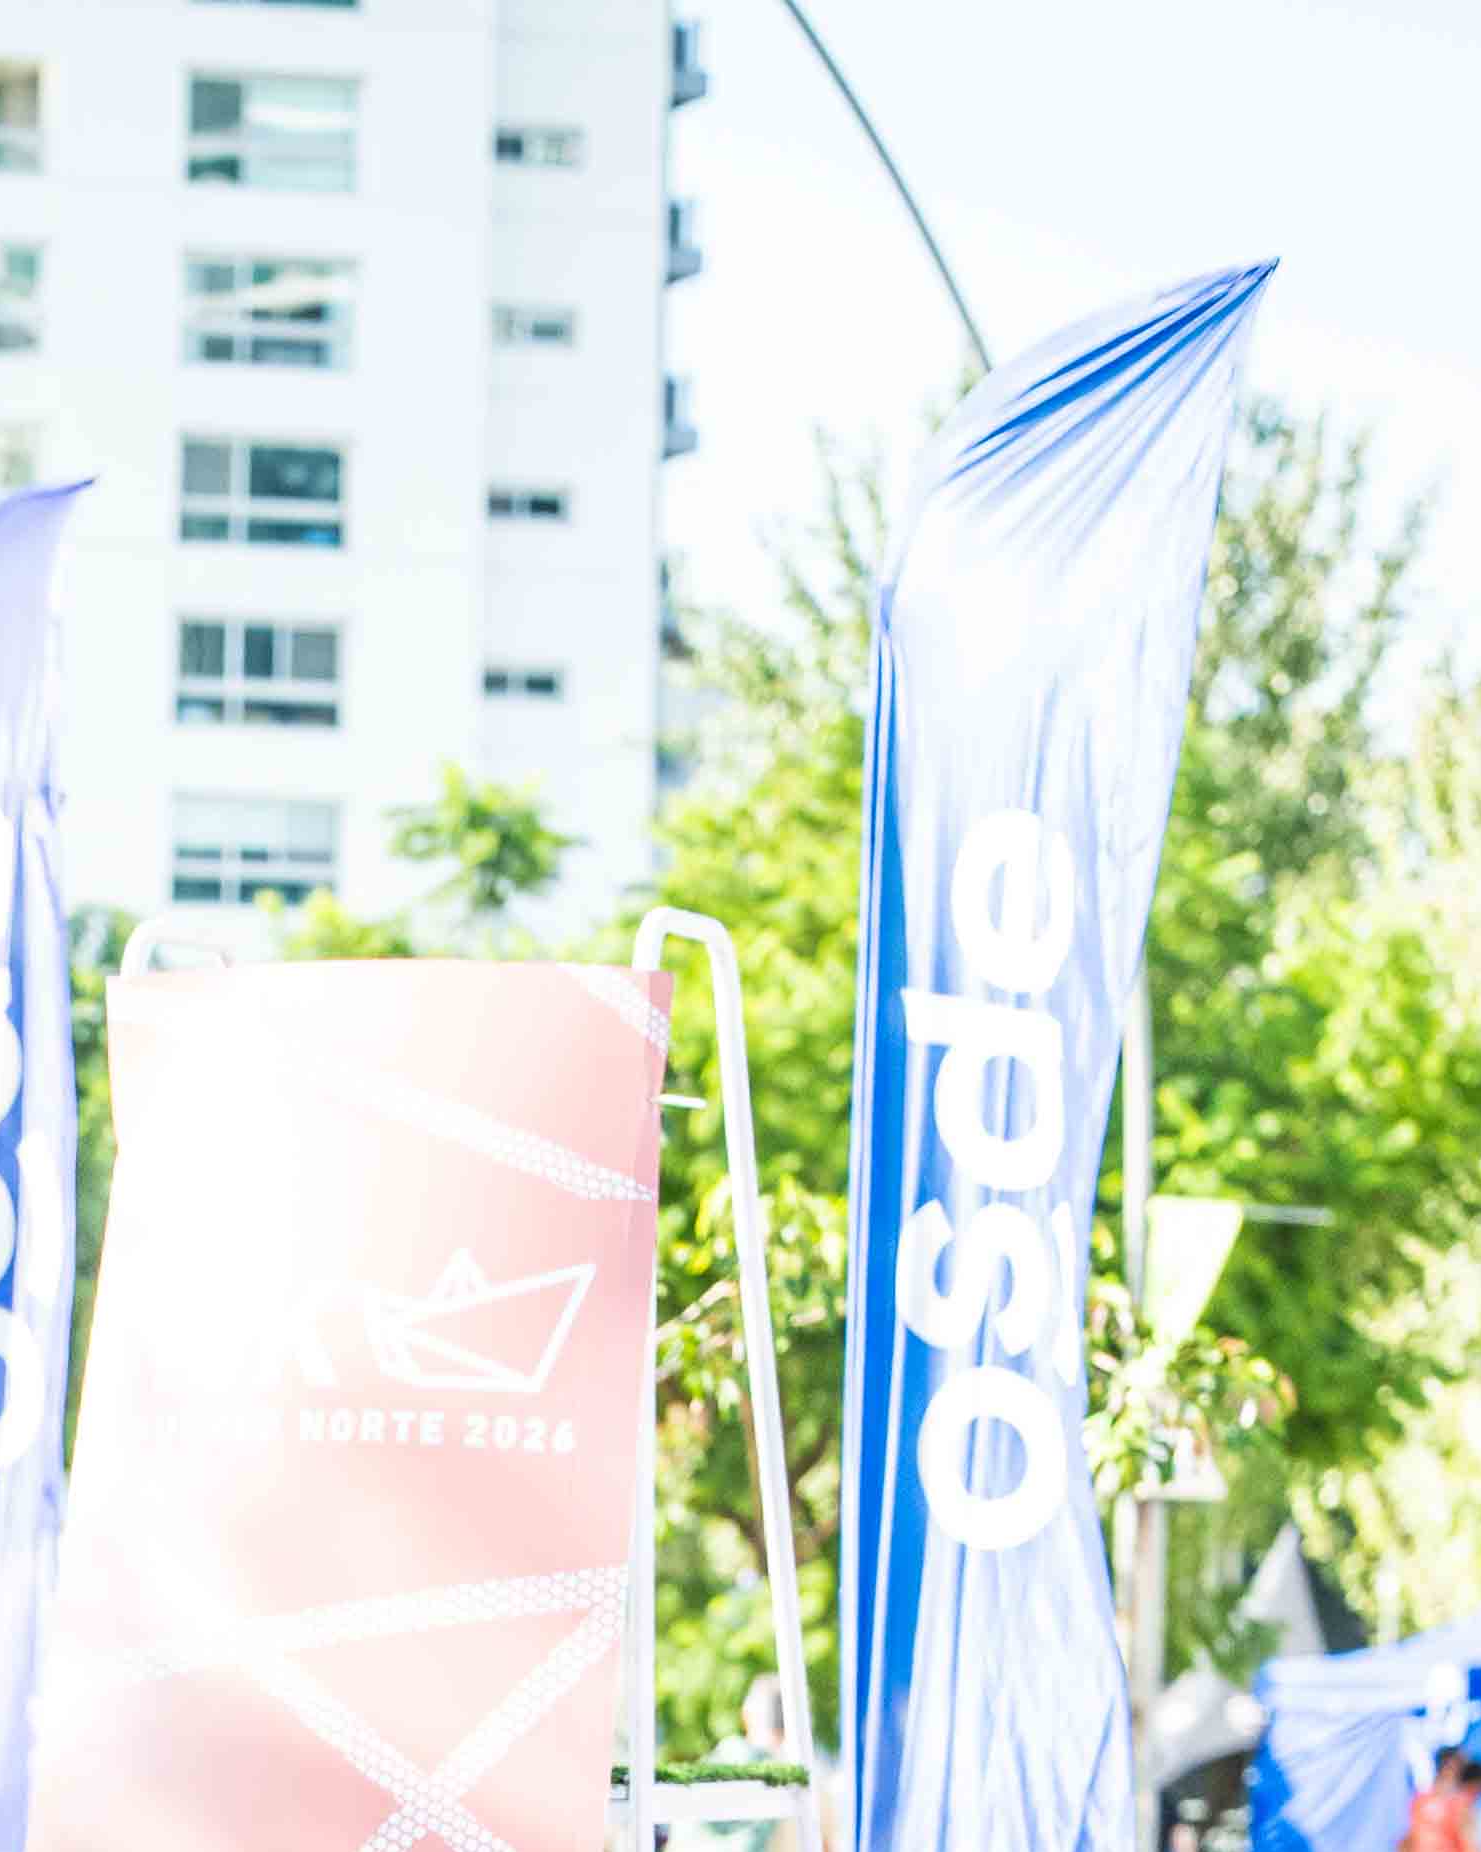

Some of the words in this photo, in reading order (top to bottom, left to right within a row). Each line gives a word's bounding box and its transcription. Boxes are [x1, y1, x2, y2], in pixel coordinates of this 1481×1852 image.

[897, 807, 1080, 1552] osde
[298, 1407, 446, 1446] NORTE
[462, 1412, 576, 1454] 2026
